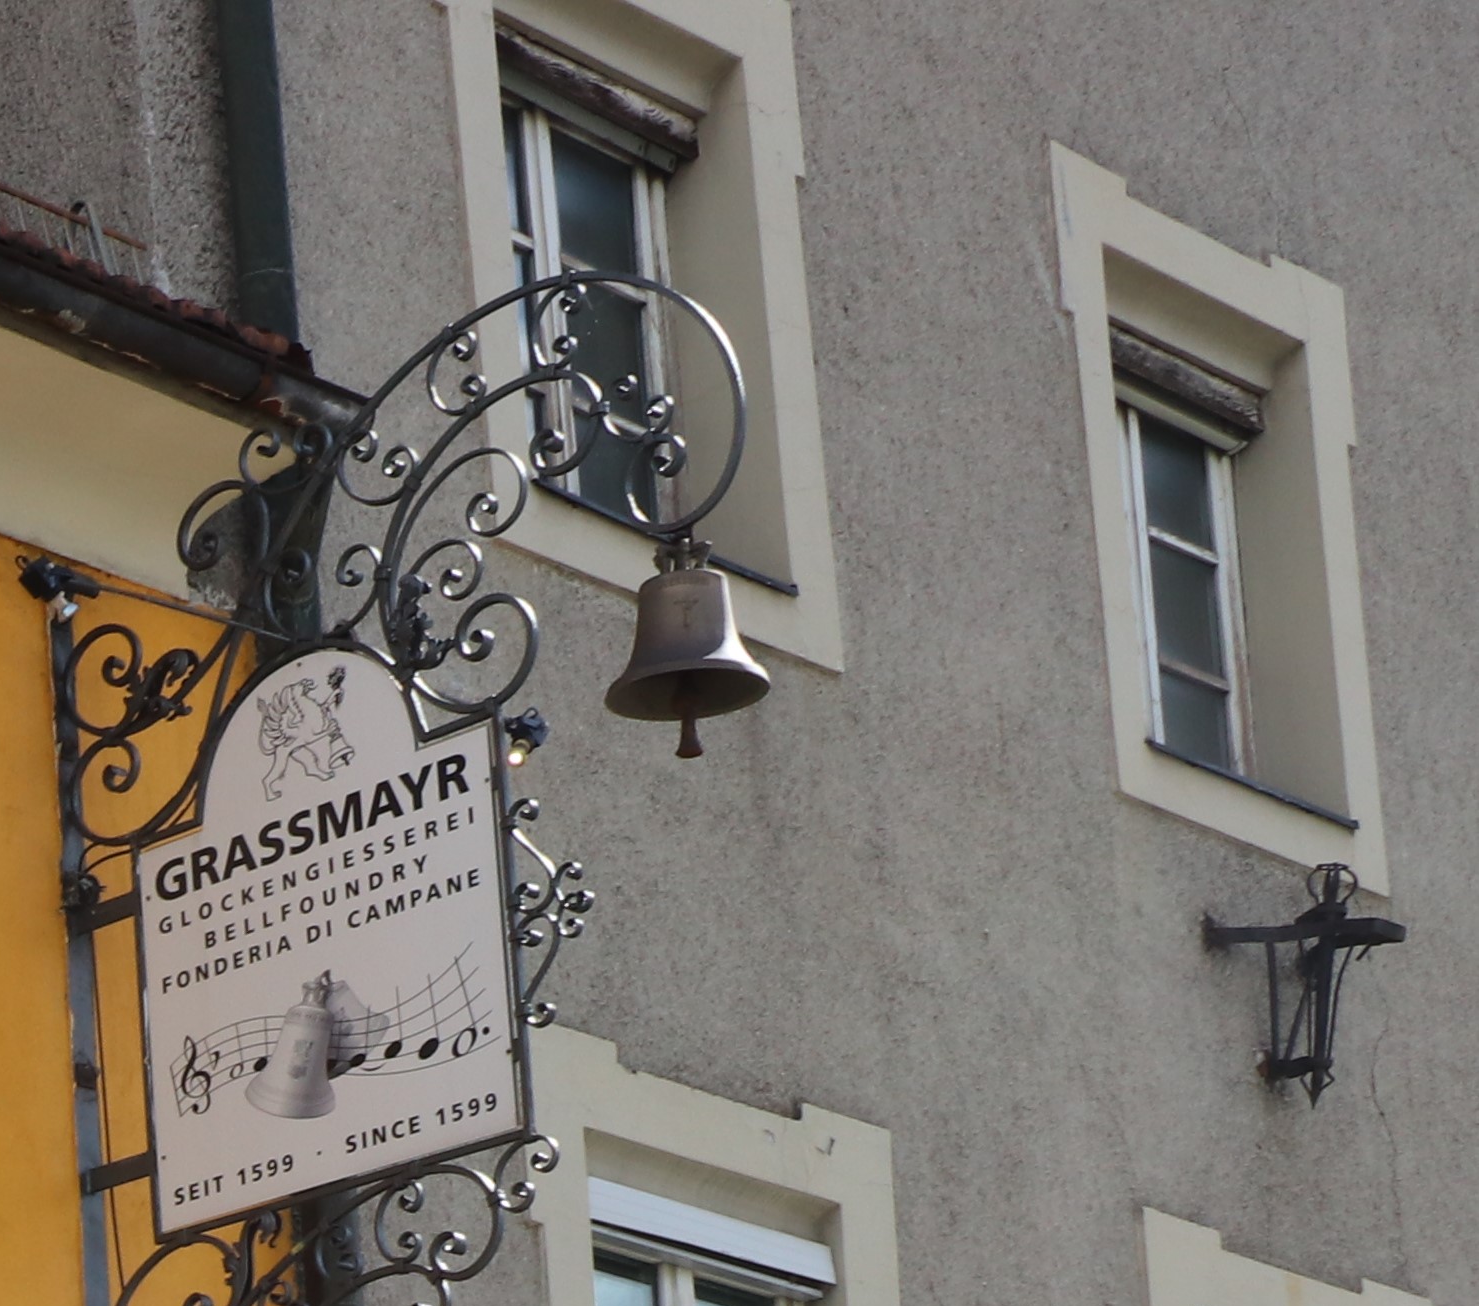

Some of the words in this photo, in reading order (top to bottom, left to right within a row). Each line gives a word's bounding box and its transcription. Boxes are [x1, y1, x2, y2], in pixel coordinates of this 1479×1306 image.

[155, 753, 470, 900] GRASSMAYR
[158, 806, 475, 935] GLOCKENGIESSEREI
[161, 934, 292, 994] FONDERIA
[306, 919, 334, 945] DI
[347, 867, 481, 930] CAMPANE
[204, 854, 428, 949] BELLFOUNDRY
[173, 1175, 224, 1206] SEIT
[236, 1153, 295, 1185] 1599
[344, 1116, 422, 1154] SINCE
[435, 1092, 498, 1127] 1599
